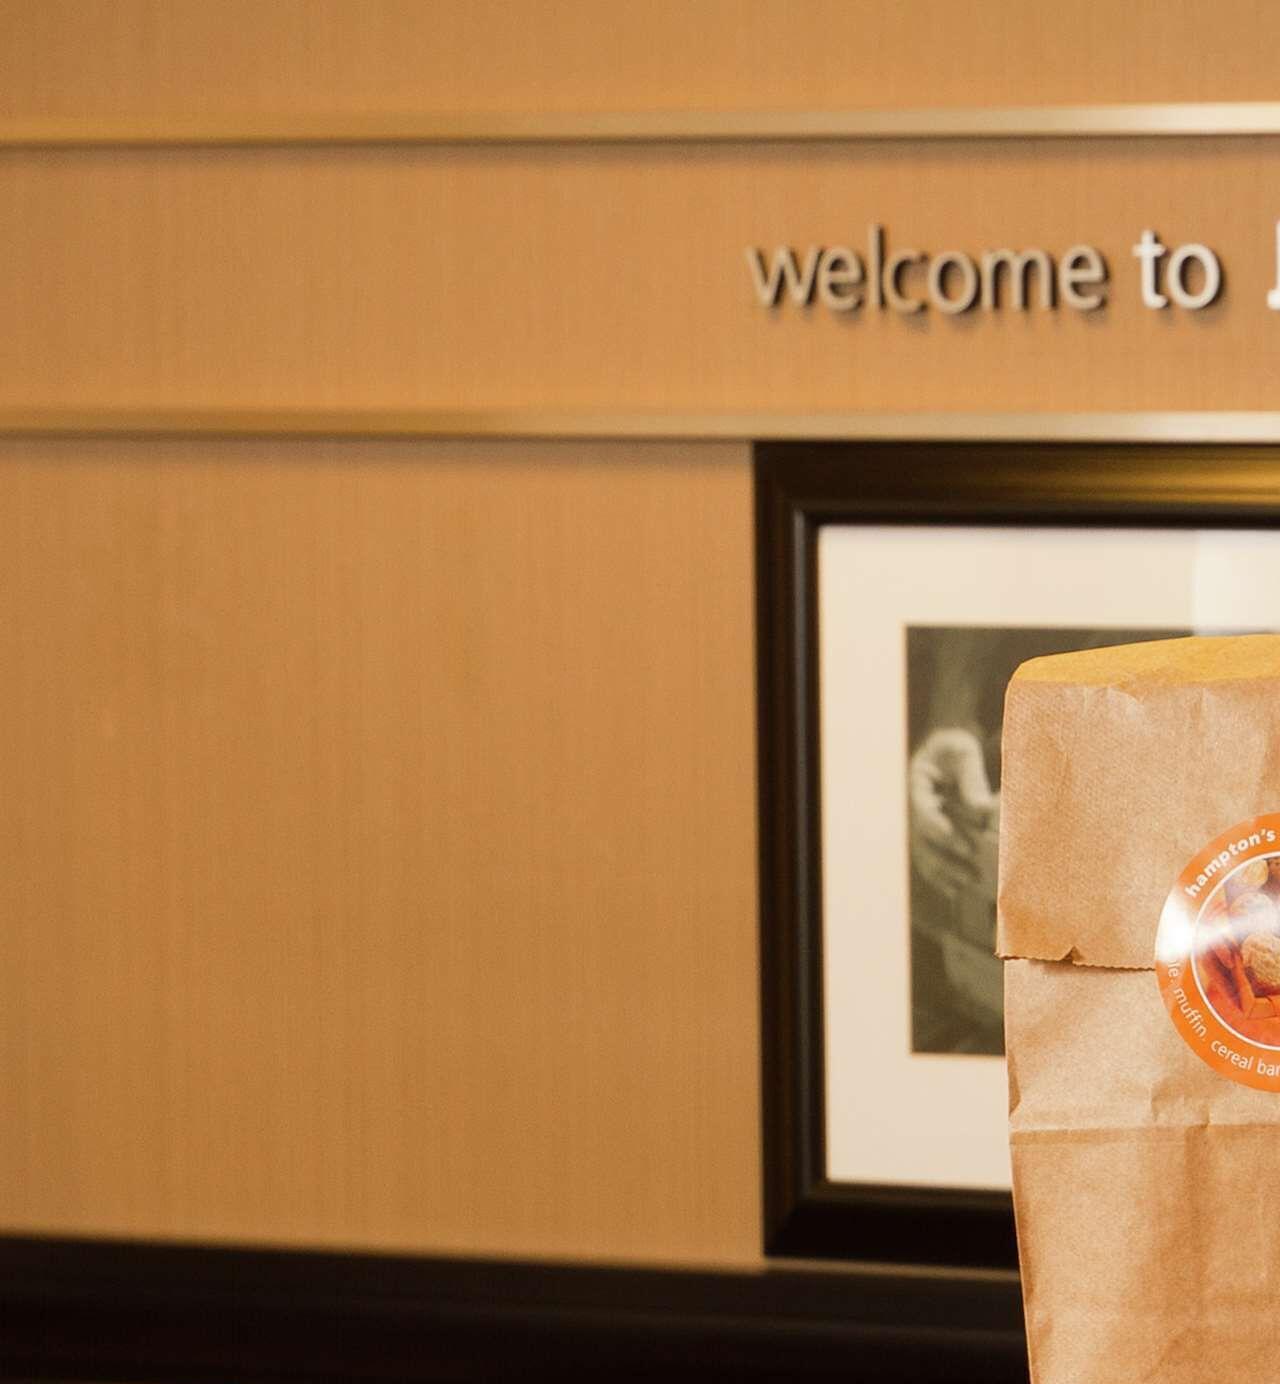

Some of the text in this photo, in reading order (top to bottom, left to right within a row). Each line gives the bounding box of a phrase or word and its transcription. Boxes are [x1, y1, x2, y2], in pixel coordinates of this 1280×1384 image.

[747, 222, 1109, 315] welcome
[1133, 228, 1224, 311] to
[1184, 828, 1277, 899] hampton's
[1210, 1040, 1254, 1071] cereal
